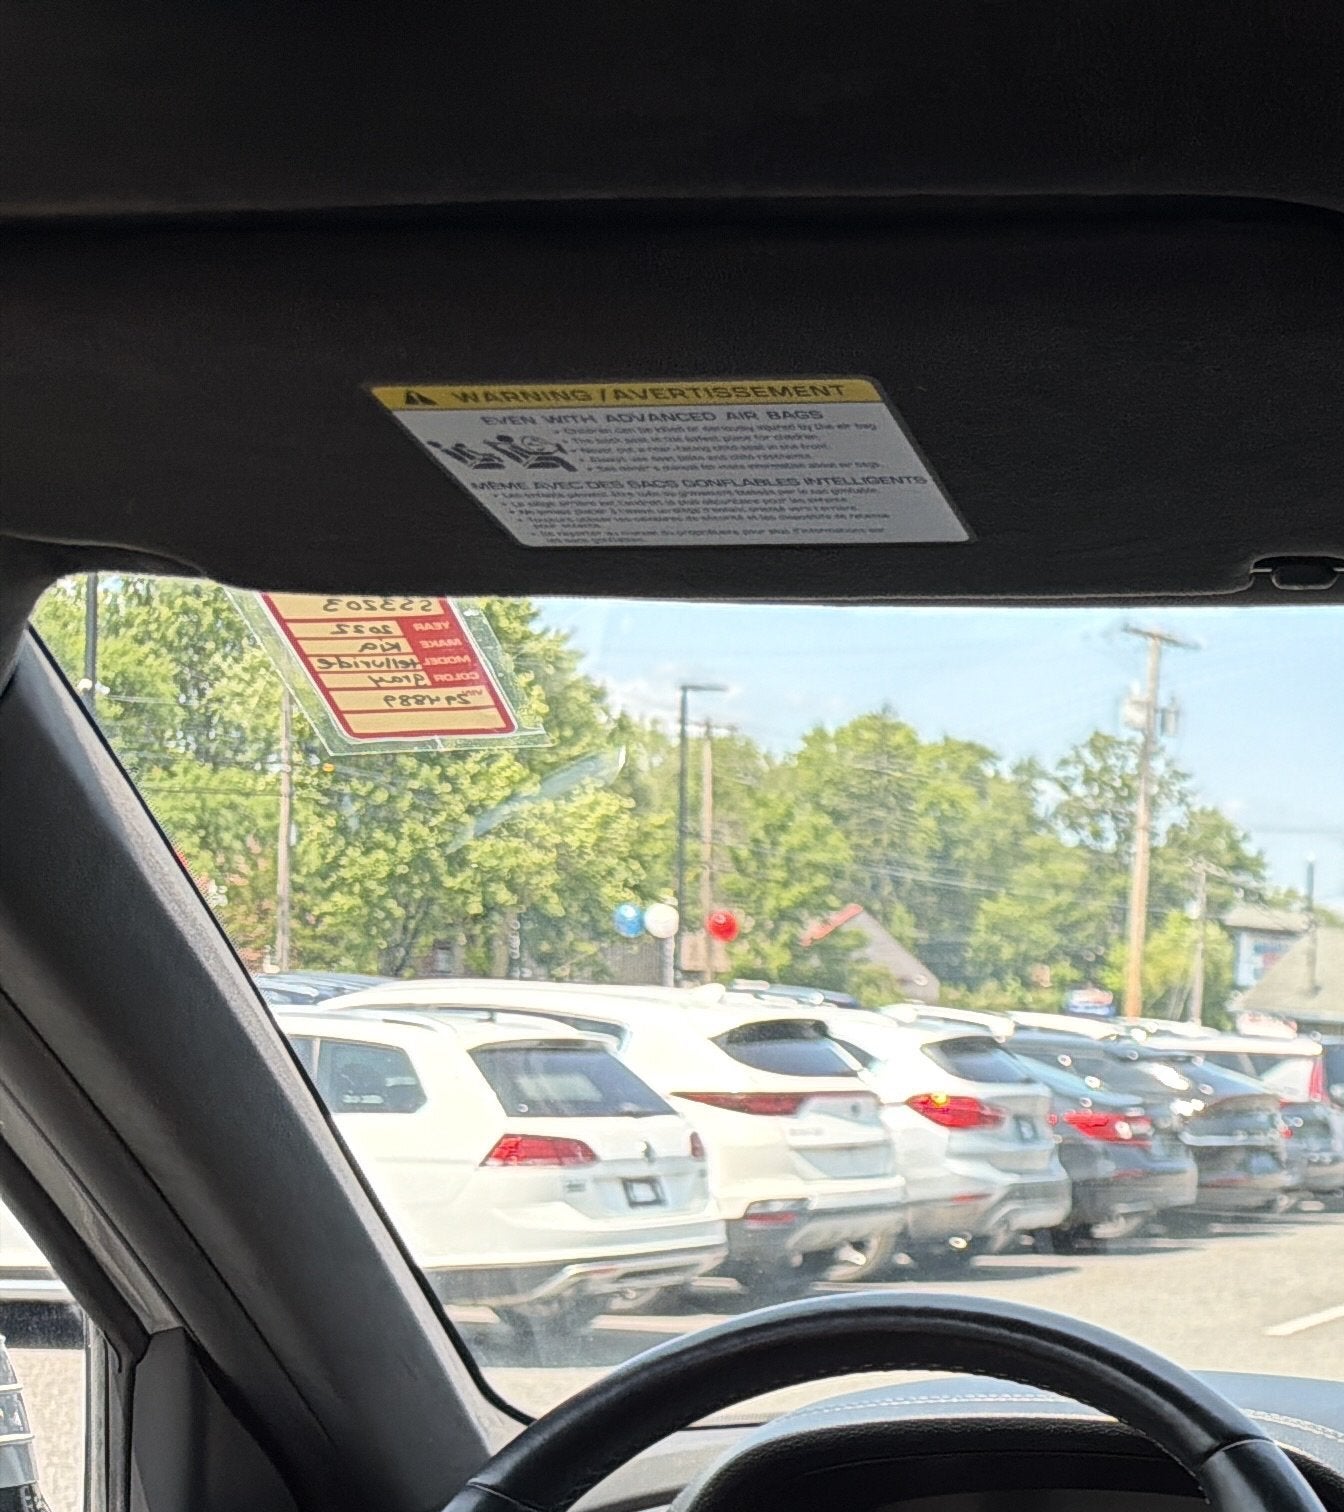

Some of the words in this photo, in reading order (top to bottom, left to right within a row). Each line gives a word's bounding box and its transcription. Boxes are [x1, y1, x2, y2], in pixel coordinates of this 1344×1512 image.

[452, 389, 592, 403] WARNING
[480, 416, 537, 426] EVEN
[541, 415, 599, 425] WITH
[605, 412, 718, 423] ADVANCED
[725, 410, 760, 422] AIR
[766, 409, 825, 420] BAGS
